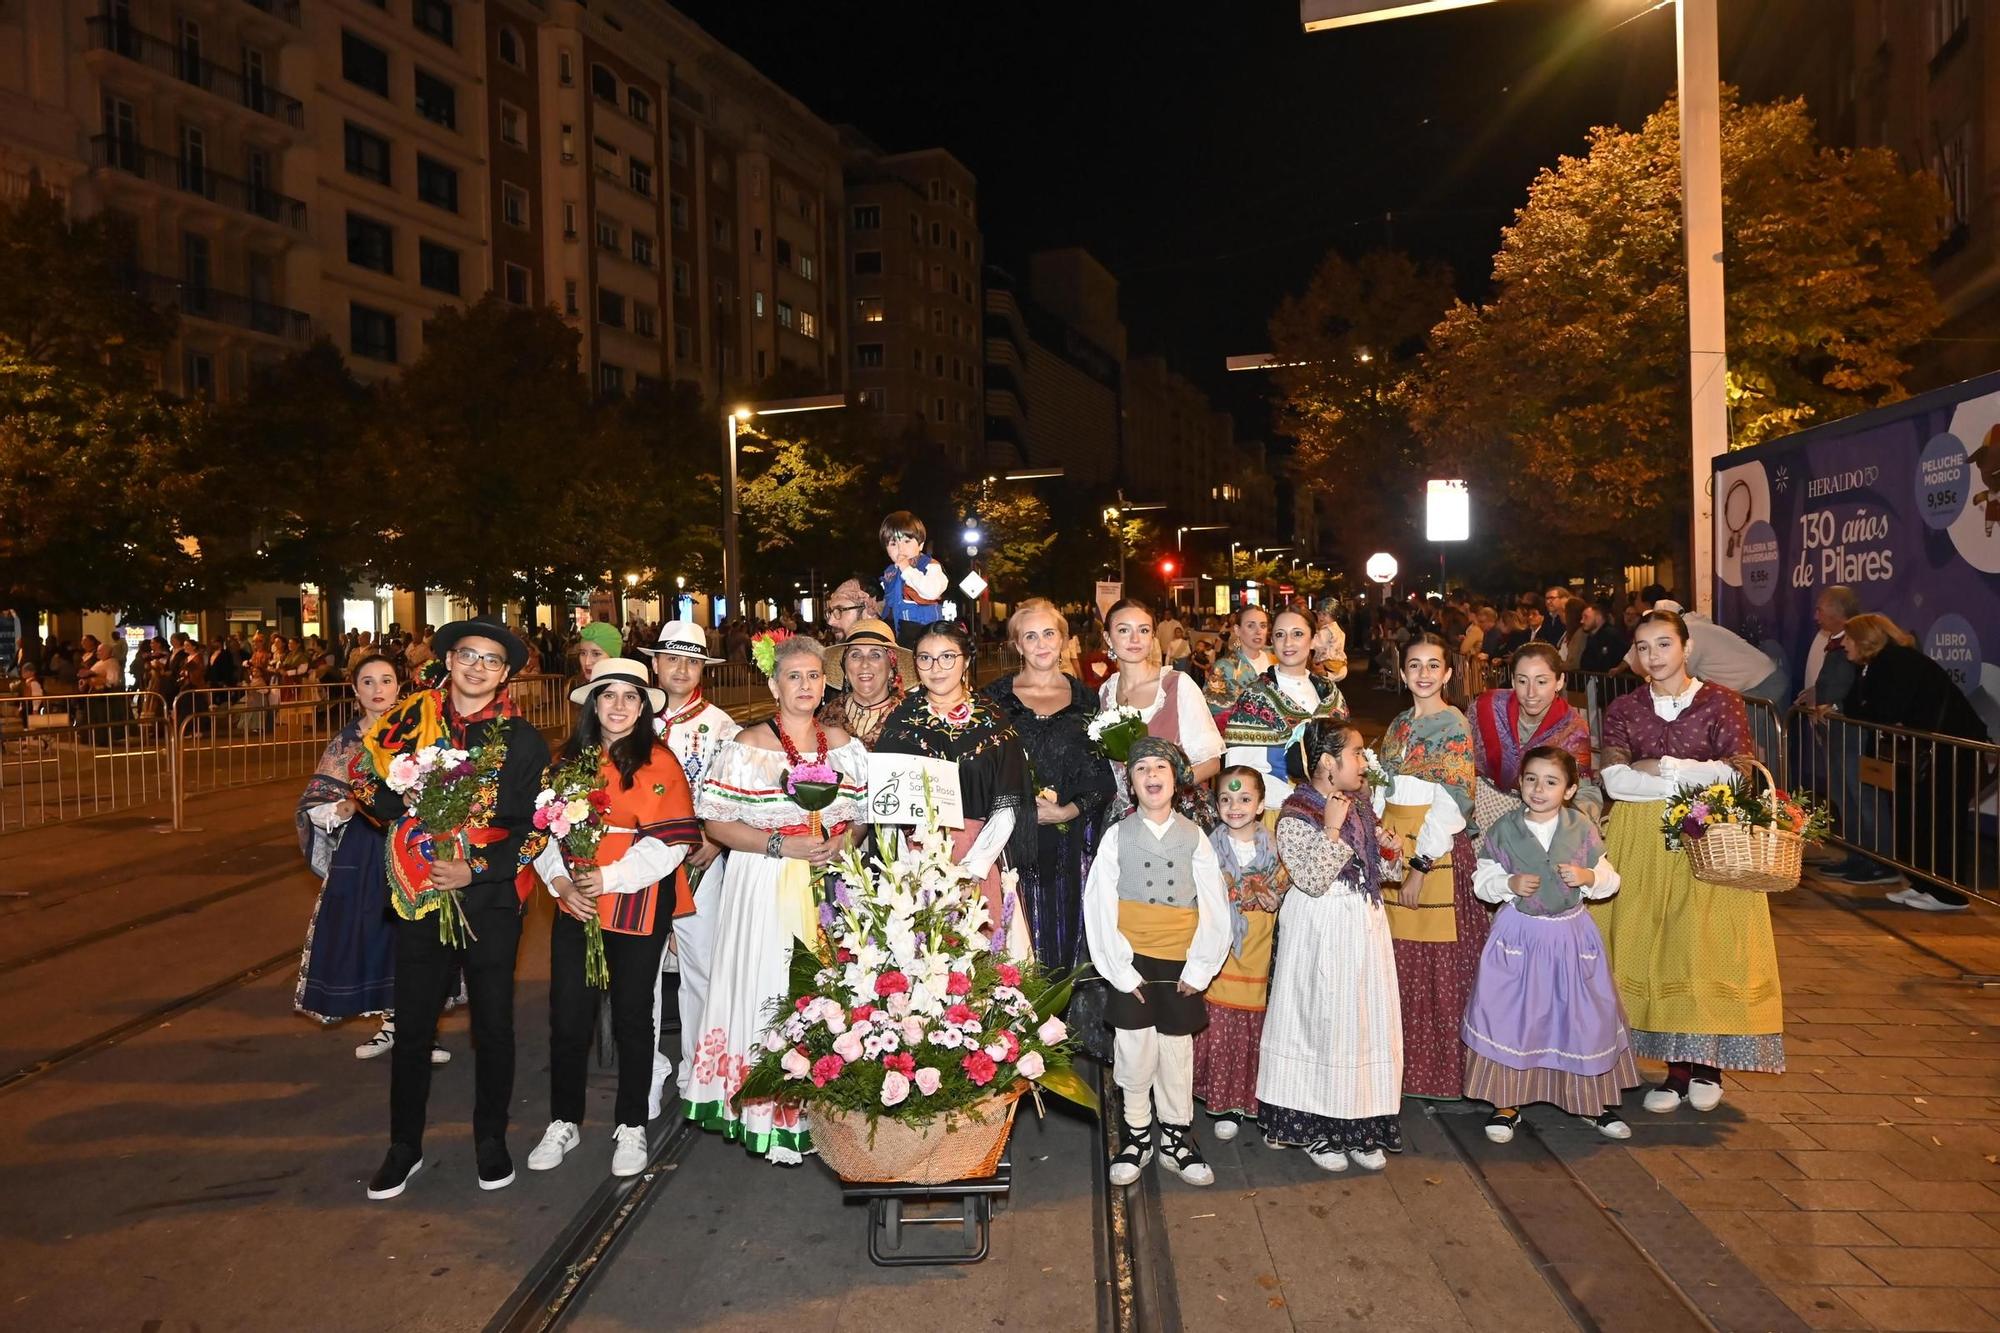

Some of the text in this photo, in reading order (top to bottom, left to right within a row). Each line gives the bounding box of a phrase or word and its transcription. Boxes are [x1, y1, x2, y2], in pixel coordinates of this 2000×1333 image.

[1922, 453, 1964, 473] PELUCHE
[1808, 469, 1863, 498] HERALDO
[1924, 468, 1961, 486] MORICO
[1927, 489, 1958, 510] 9,95€
[1800, 508, 1889, 549] 130 años
[1792, 545, 1894, 588] de Pilares
[665, 640, 701, 653] Ecuador
[1935, 633, 1967, 646] LIBRO
[1930, 647, 1972, 661] LA JOTA
[936, 784, 955, 797] Rosa
